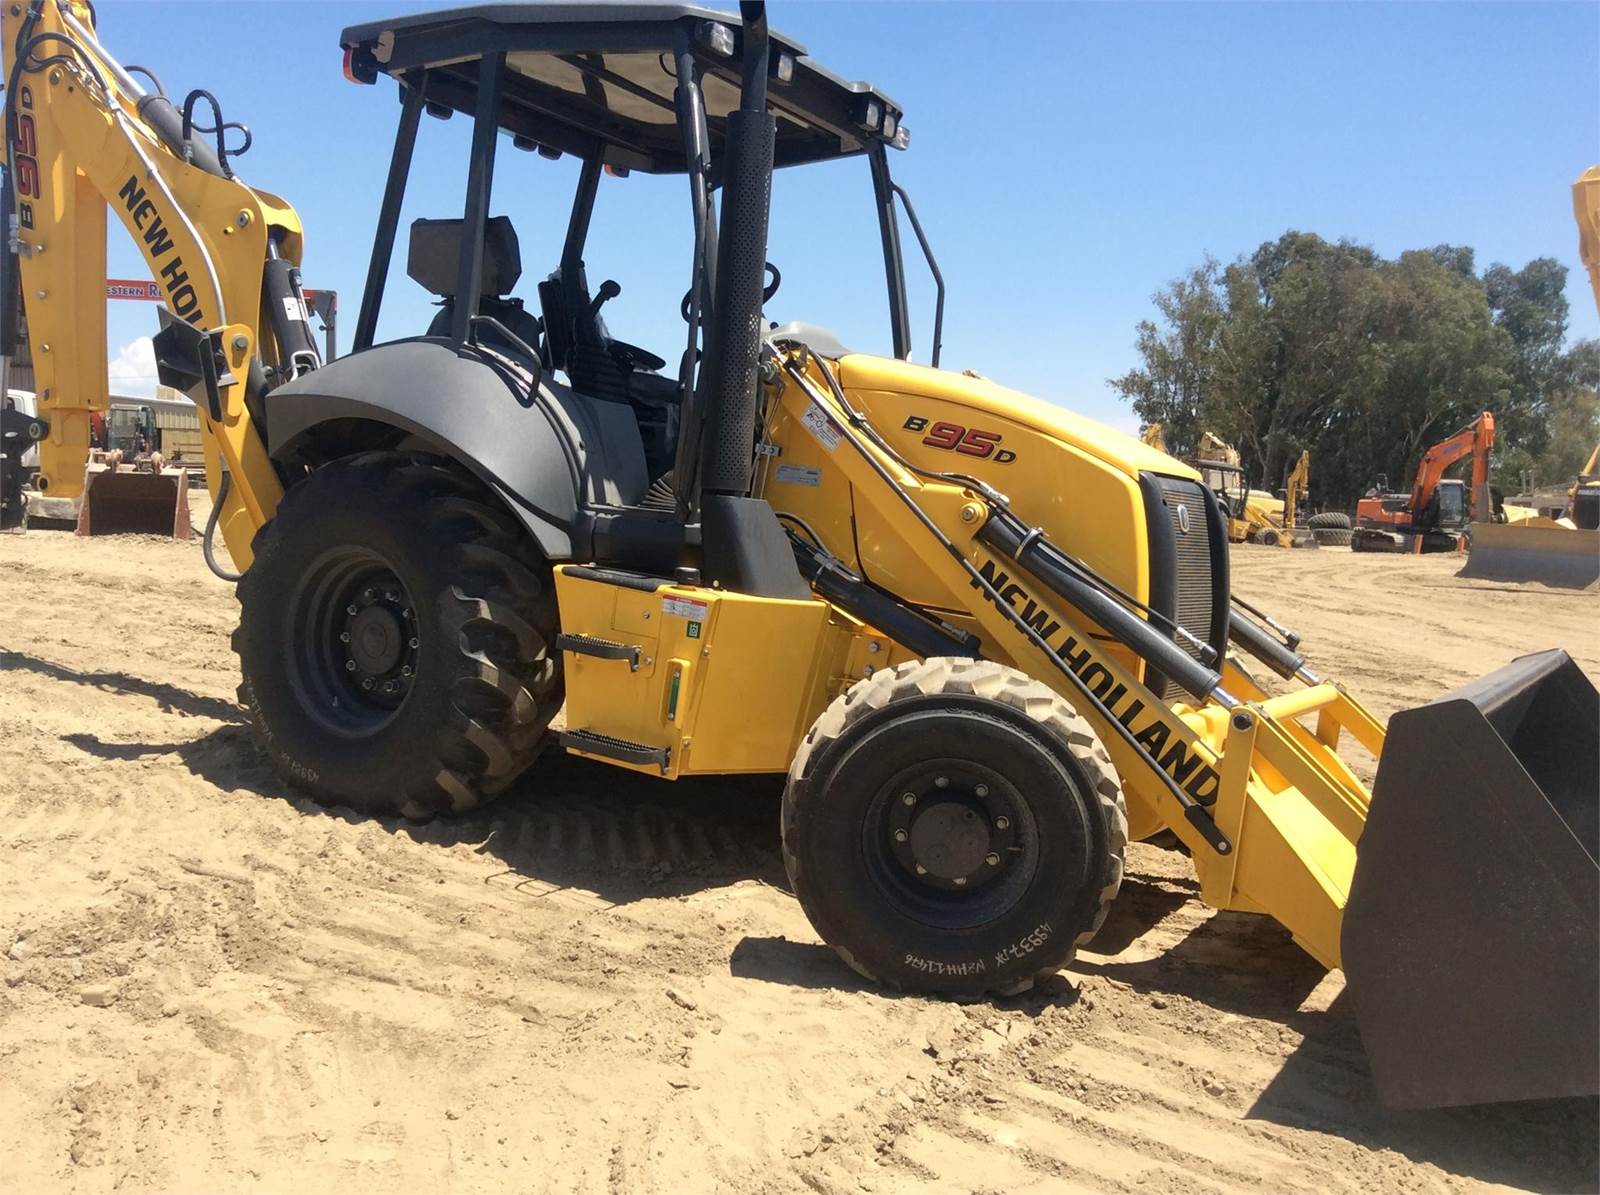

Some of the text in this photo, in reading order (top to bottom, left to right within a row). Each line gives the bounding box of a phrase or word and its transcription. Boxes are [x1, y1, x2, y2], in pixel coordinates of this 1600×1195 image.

[119, 175, 208, 333] NEW HOL
[902, 415, 1017, 463] B95D
[969, 559, 1061, 648] NEW
[1053, 635, 1220, 808] HOLLAND
